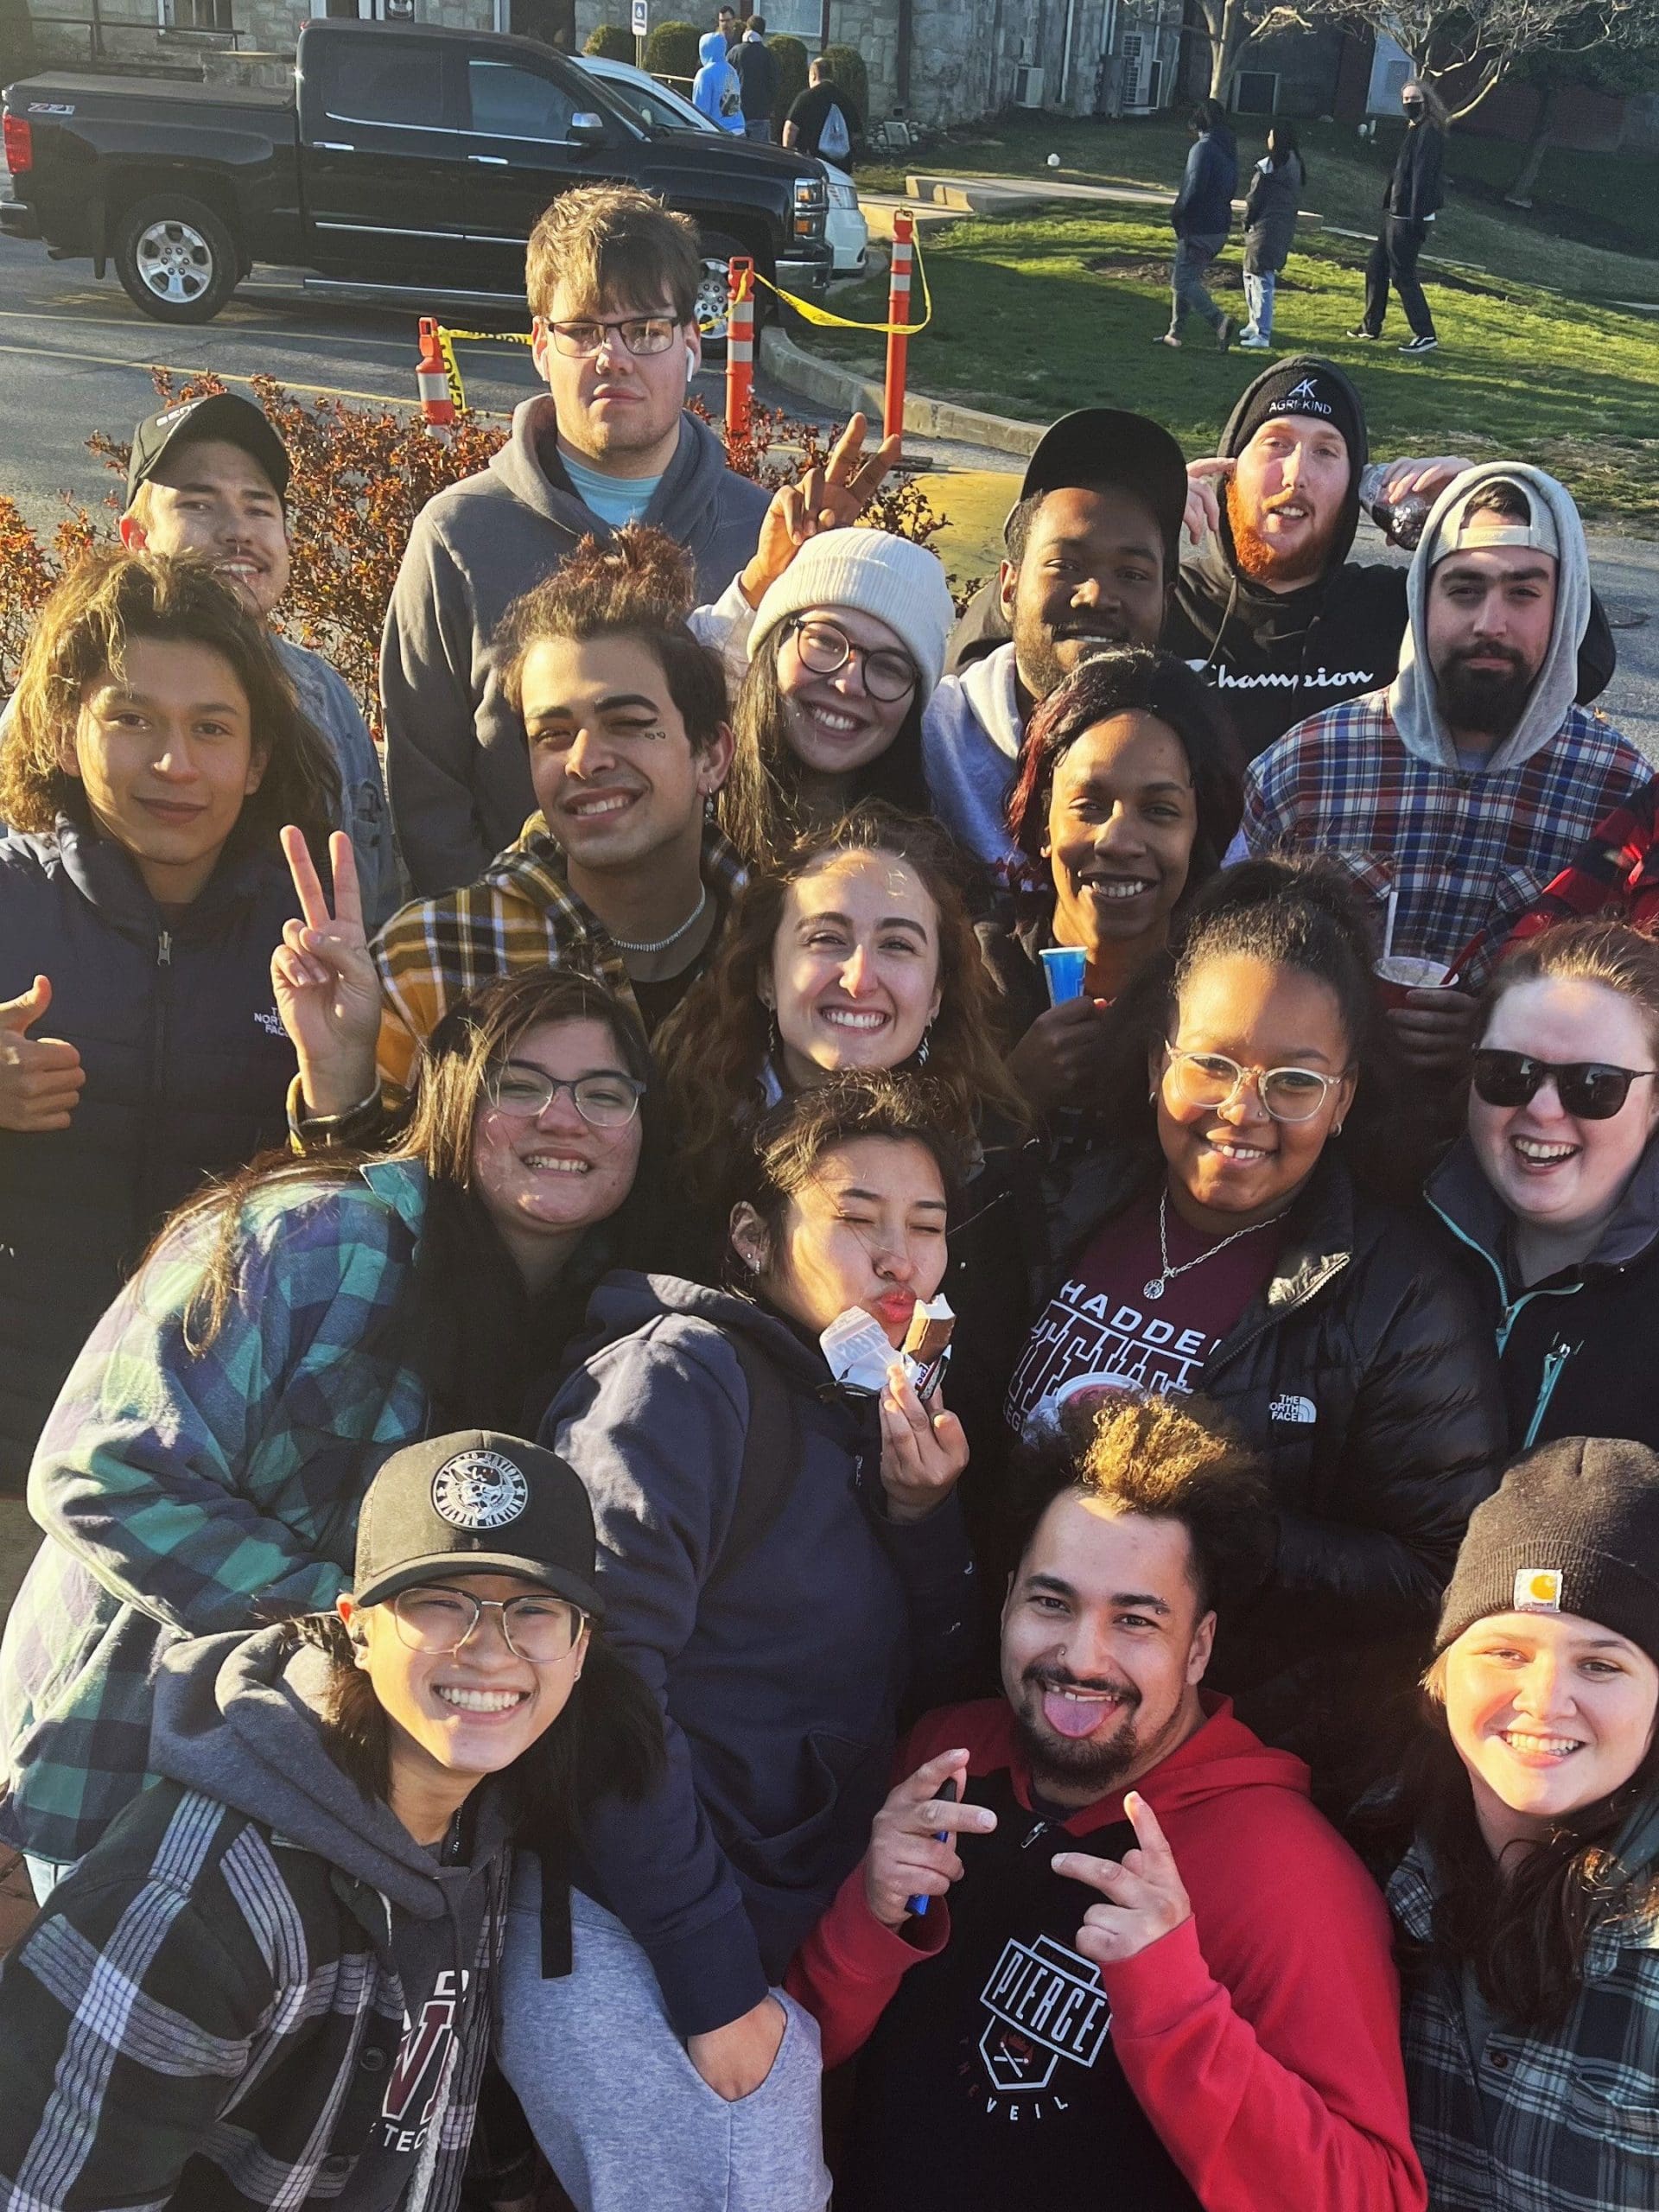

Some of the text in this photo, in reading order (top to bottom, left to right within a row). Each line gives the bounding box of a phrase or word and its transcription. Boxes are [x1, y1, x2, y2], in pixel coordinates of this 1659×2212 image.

[1288, 378, 1318, 397] AK
[1268, 398, 1332, 415] AGRI-KIND
[265, 1024, 288, 1037] FAC
[1059, 1279, 1222, 1355] HADDE
[1268, 1402, 1299, 1414] ORTH
[1279, 1394, 1300, 1405] THE
[1271, 1411, 1298, 1422] FACE
[992, 1950, 1106, 2053] PIERCE
[986, 2096, 1069, 2120] VEIL
